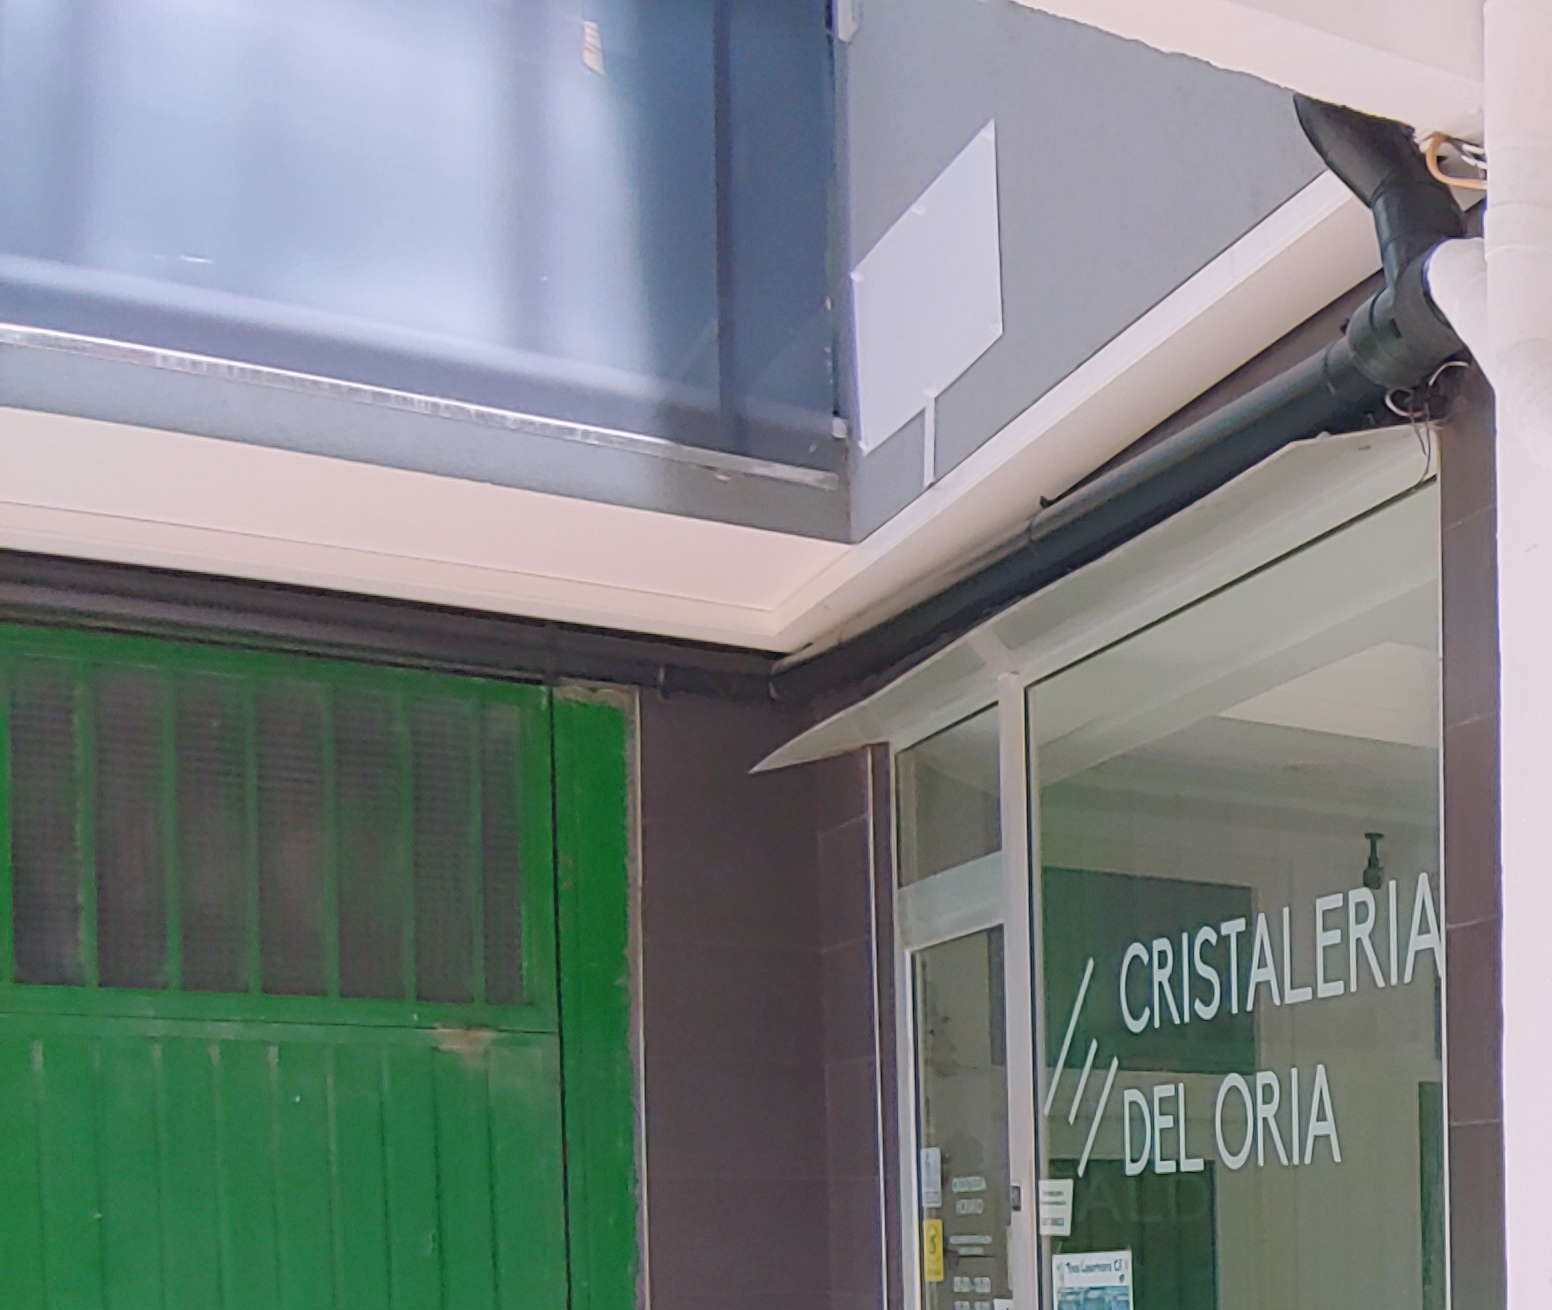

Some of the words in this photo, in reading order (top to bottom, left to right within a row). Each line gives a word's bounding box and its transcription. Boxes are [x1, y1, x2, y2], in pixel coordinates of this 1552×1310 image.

[1119, 872, 1442, 1033] CRISTALERIA
[1123, 1082, 1204, 1176] DEL
[1215, 1064, 1342, 1170] ORIA
